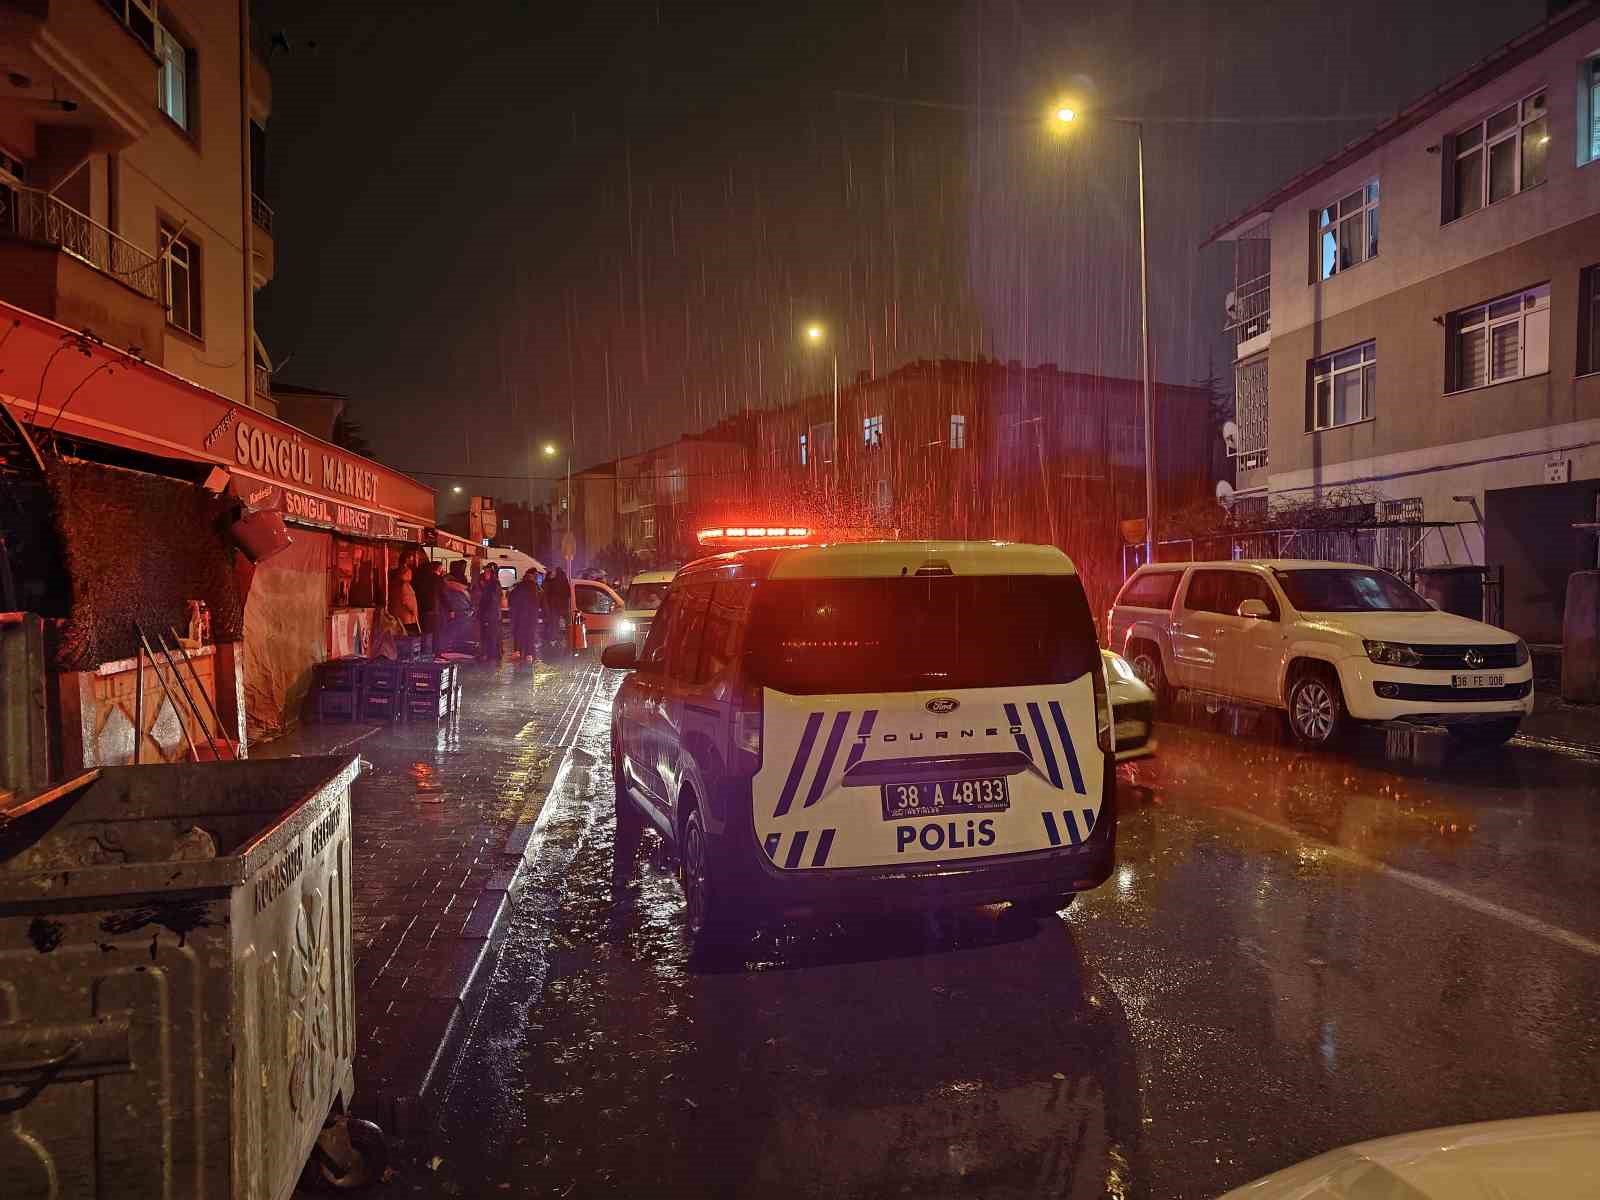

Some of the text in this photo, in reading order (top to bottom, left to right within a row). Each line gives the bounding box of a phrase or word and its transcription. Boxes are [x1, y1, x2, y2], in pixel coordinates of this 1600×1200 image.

[236, 421, 379, 503] SONGÜL MARKET
[336, 504, 371, 530] MARKET
[857, 726, 1022, 743] TOURNEO
[896, 779, 1005, 808] 38 A 48133
